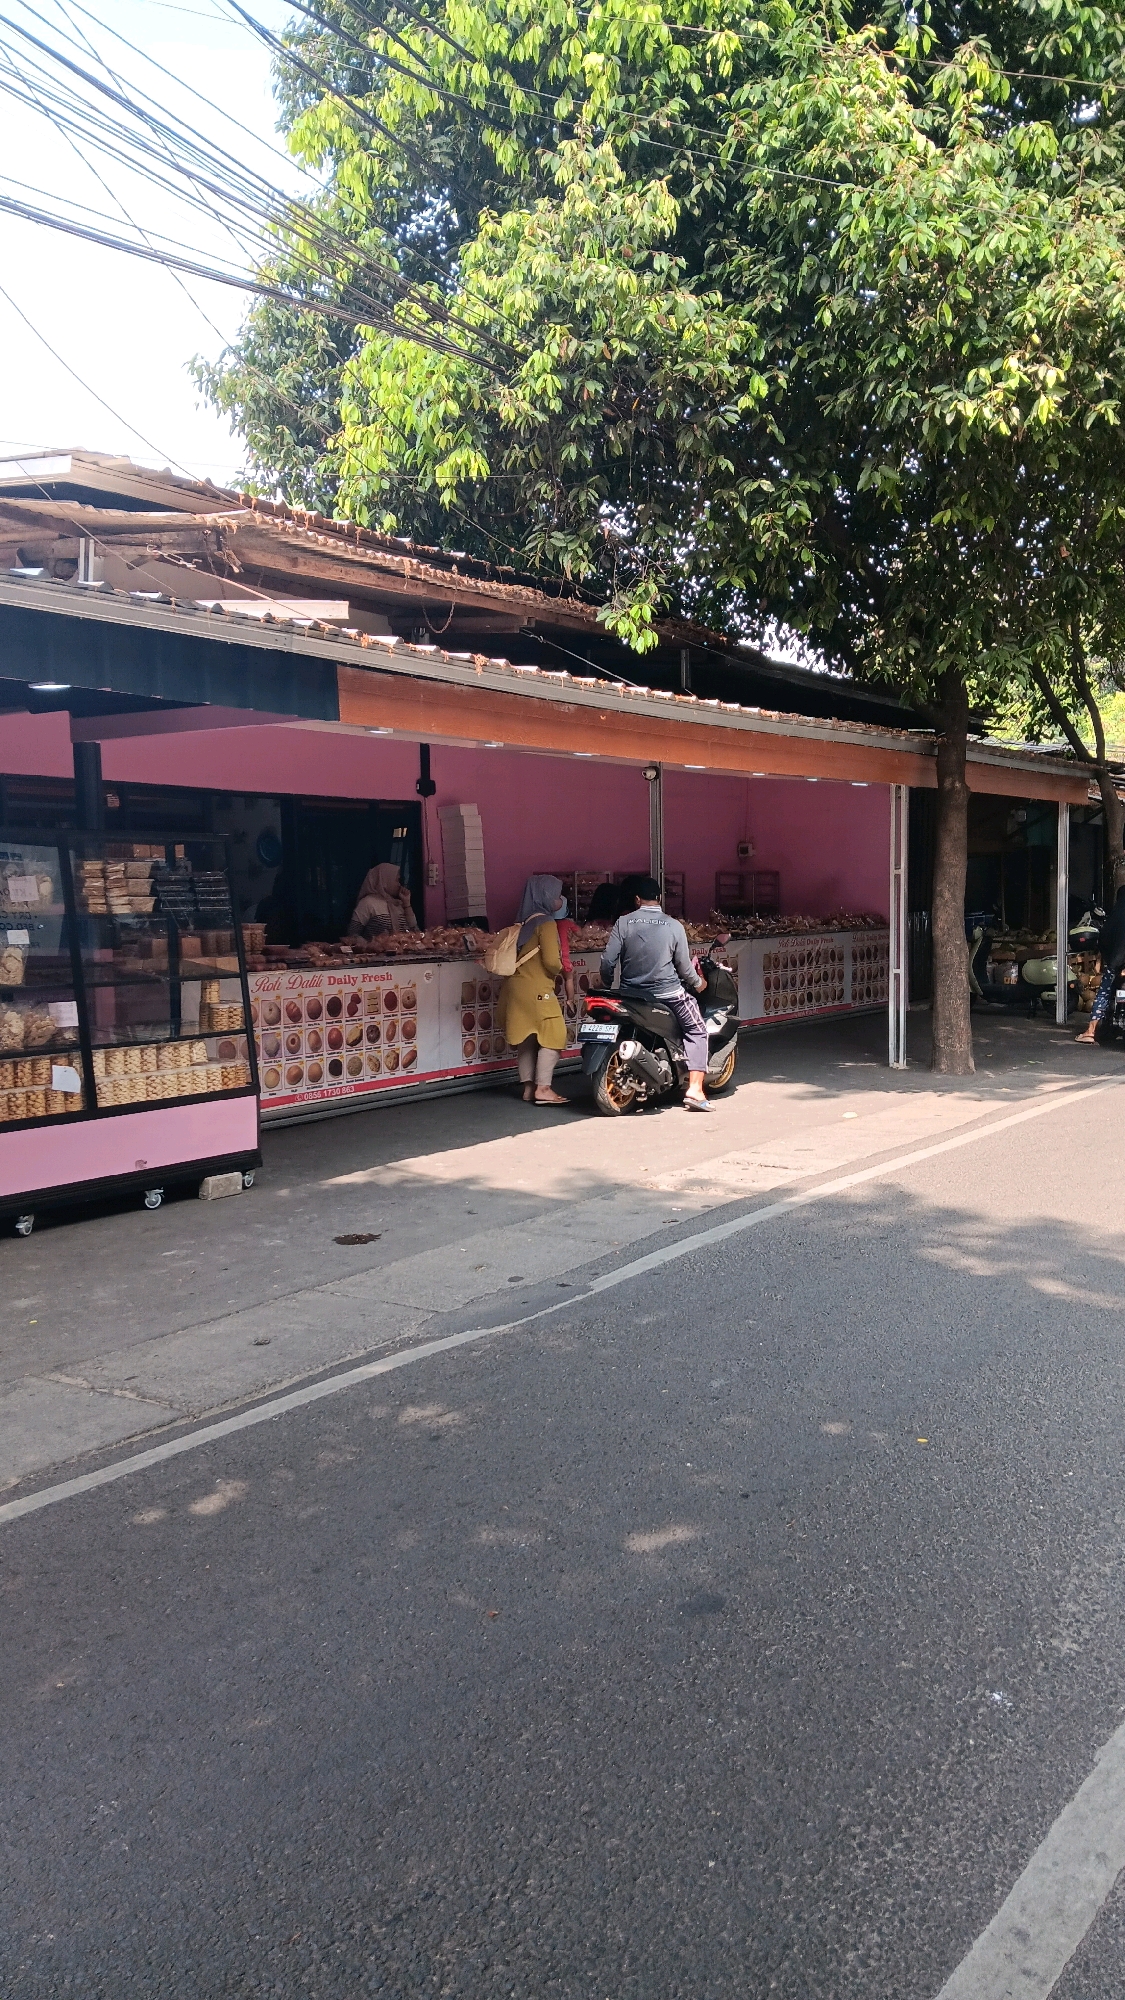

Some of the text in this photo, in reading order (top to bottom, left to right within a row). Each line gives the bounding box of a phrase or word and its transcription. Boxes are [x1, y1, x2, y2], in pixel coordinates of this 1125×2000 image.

[691, 947, 708, 956] Daily
[251, 976, 283, 993] Roti
[327, 975, 358, 987] Daily
[361, 972, 393, 983] Fresh
[323, 1087, 340, 1097] 1730
[341, 1085, 355, 1094] 863
